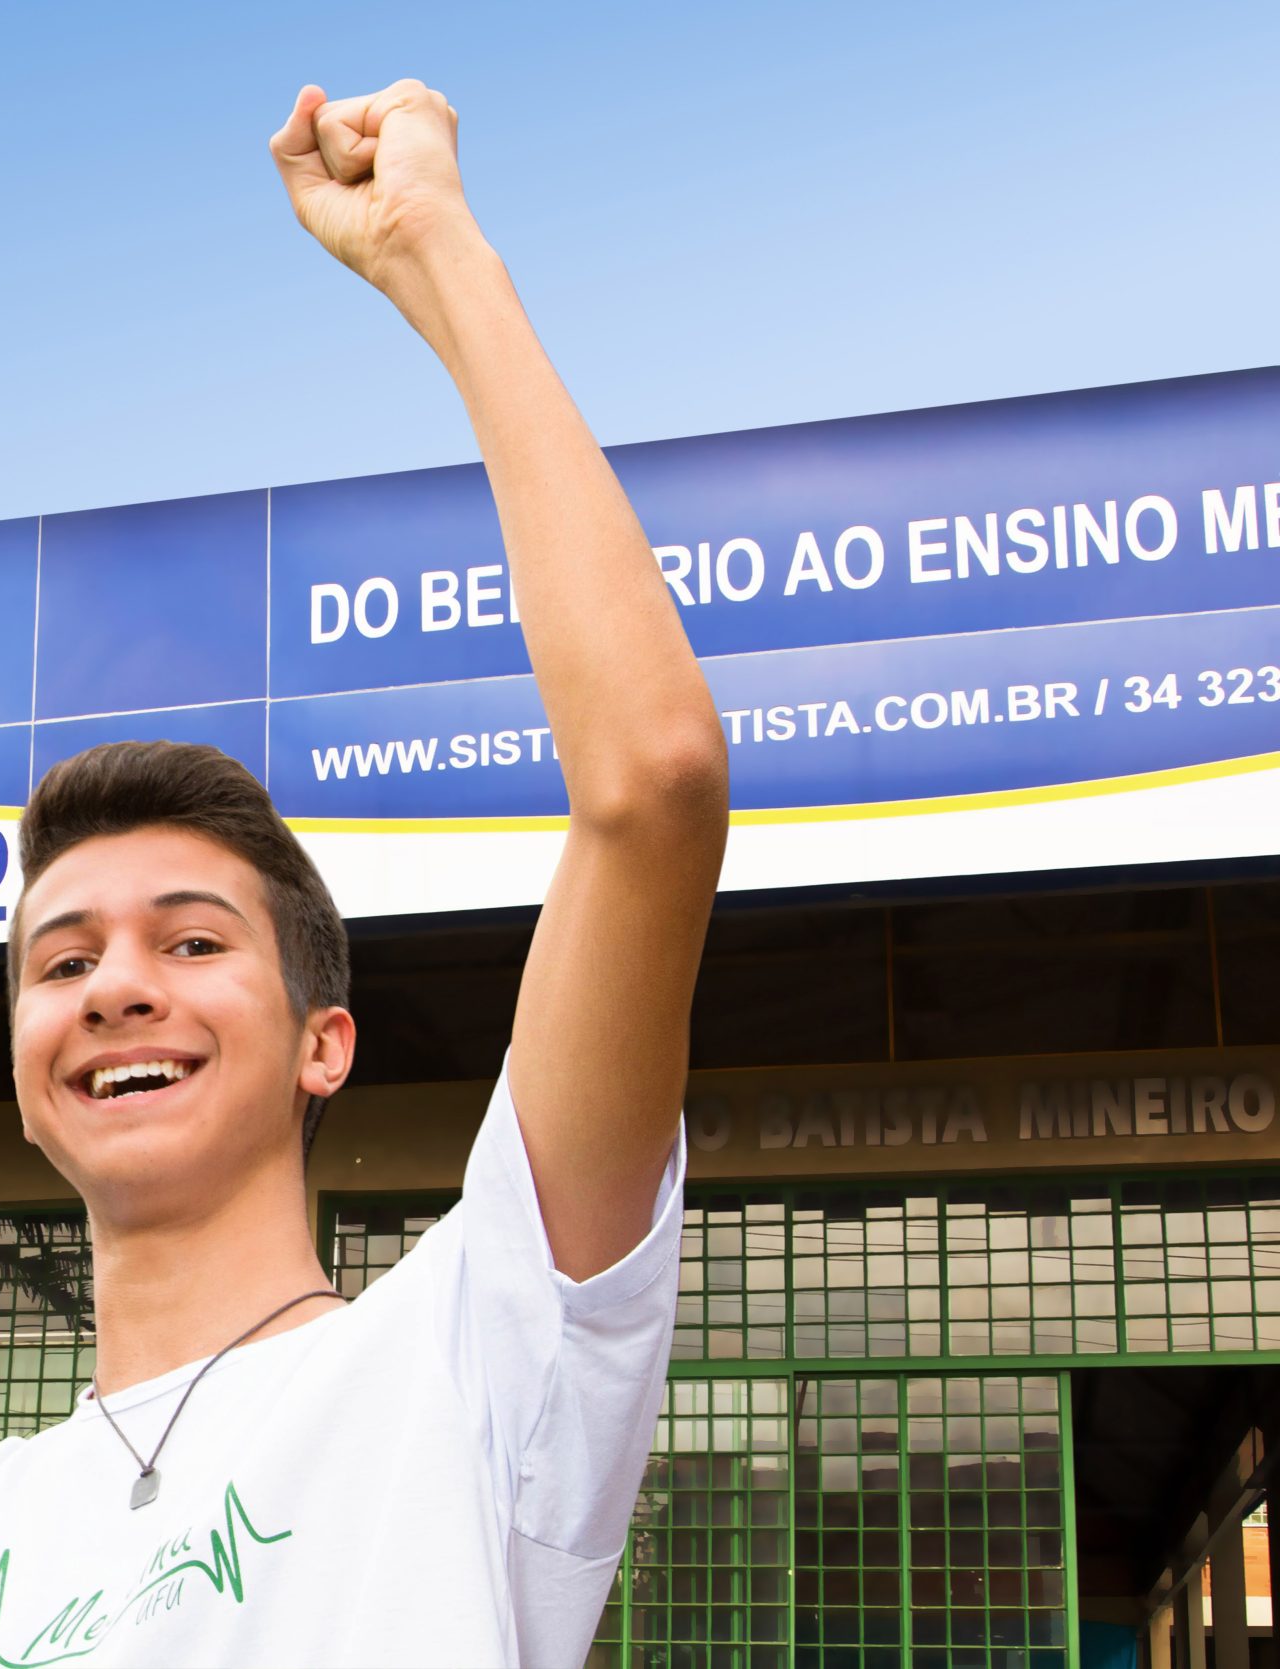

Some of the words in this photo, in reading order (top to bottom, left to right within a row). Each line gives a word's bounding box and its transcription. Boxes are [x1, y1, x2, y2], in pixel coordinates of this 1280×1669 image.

[310, 577, 399, 644] DO
[420, 537, 765, 632] BERIO
[783, 525, 885, 596] AO
[907, 494, 1178, 584] ENSINO
[311, 682, 1081, 781] WWW.SISTTISTA.COM.BR
[1123, 673, 1183, 713] 34
[759, 1084, 989, 1150] BATISTA
[1018, 1073, 1276, 1141] MINEIRO
